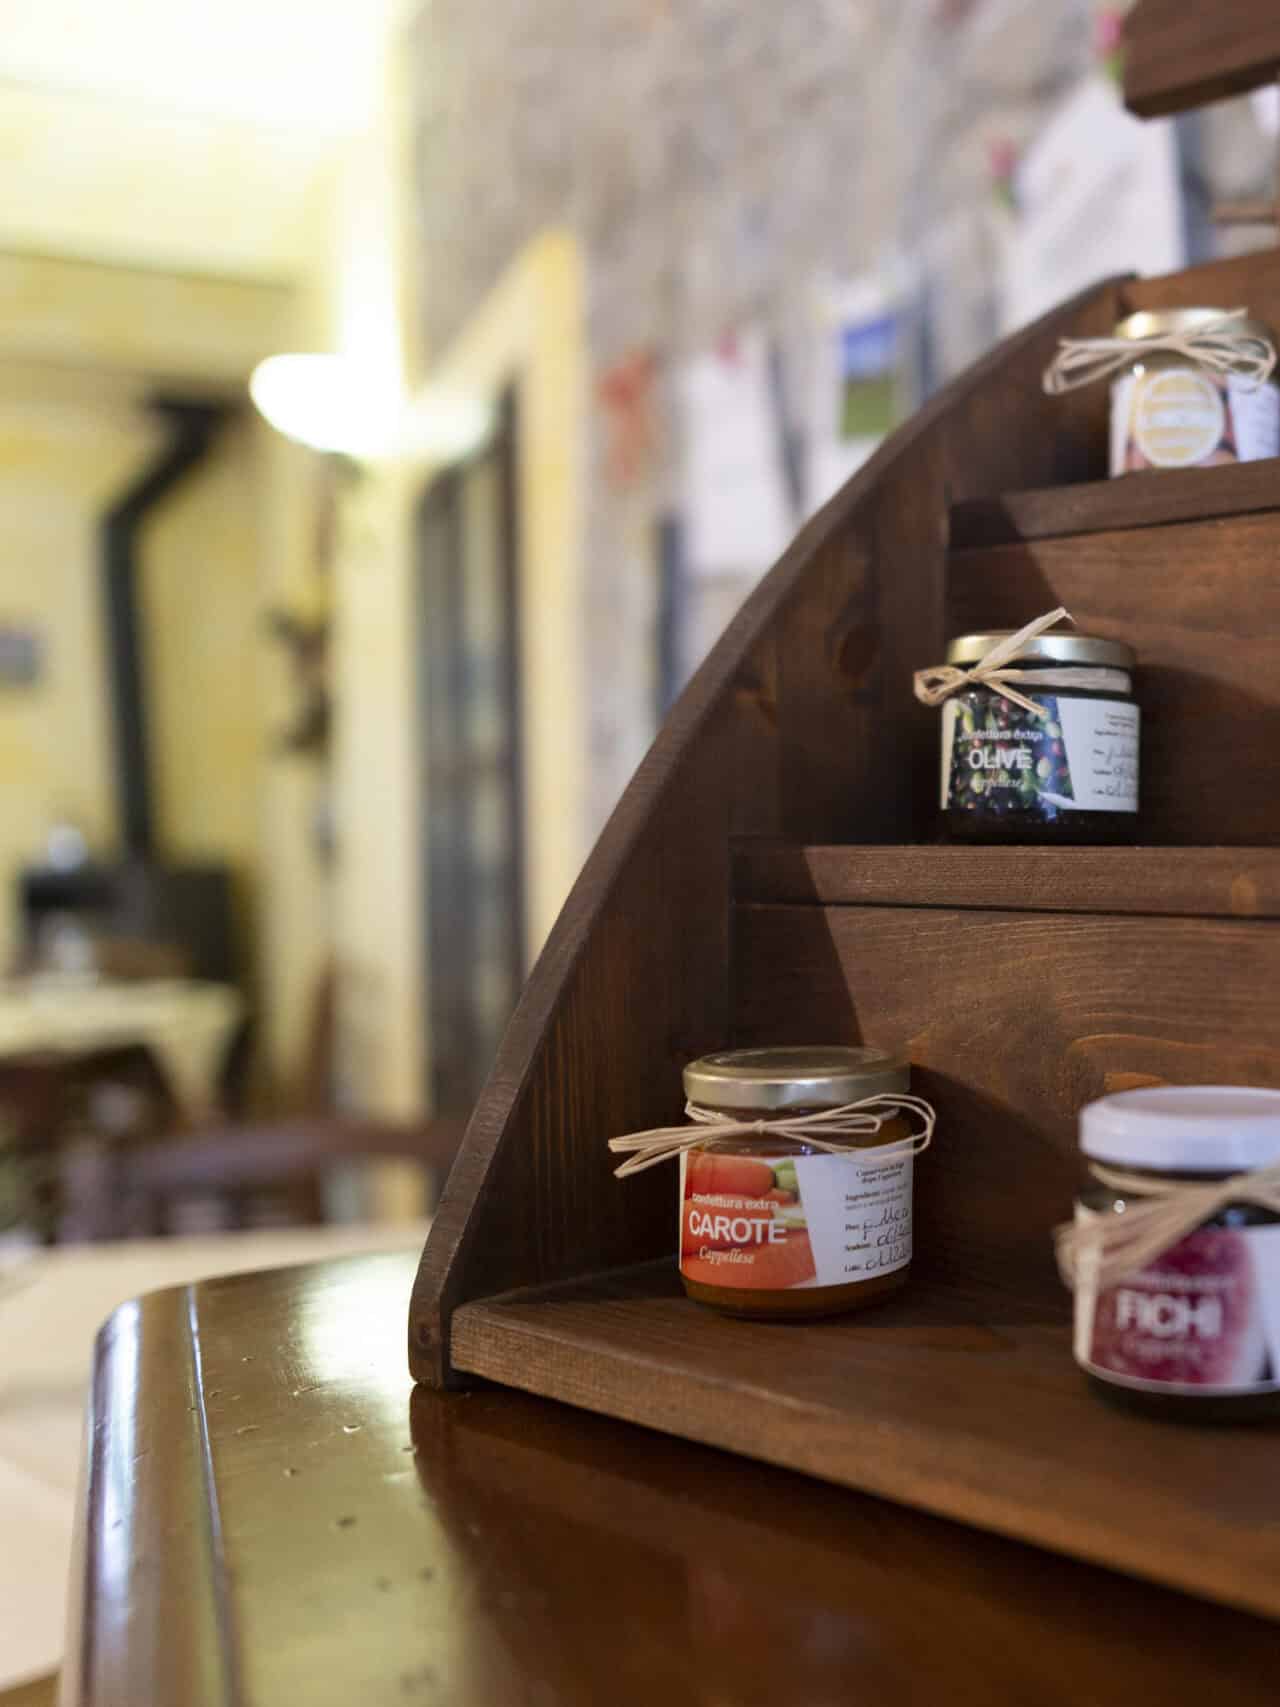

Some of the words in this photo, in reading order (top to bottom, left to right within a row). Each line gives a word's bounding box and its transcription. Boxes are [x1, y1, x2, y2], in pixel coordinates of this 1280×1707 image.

[968, 748, 1033, 769] OLIVE
[691, 1192, 743, 1211] confettura
[743, 1198, 780, 1210] extra
[688, 1211, 789, 1245] CAROTE
